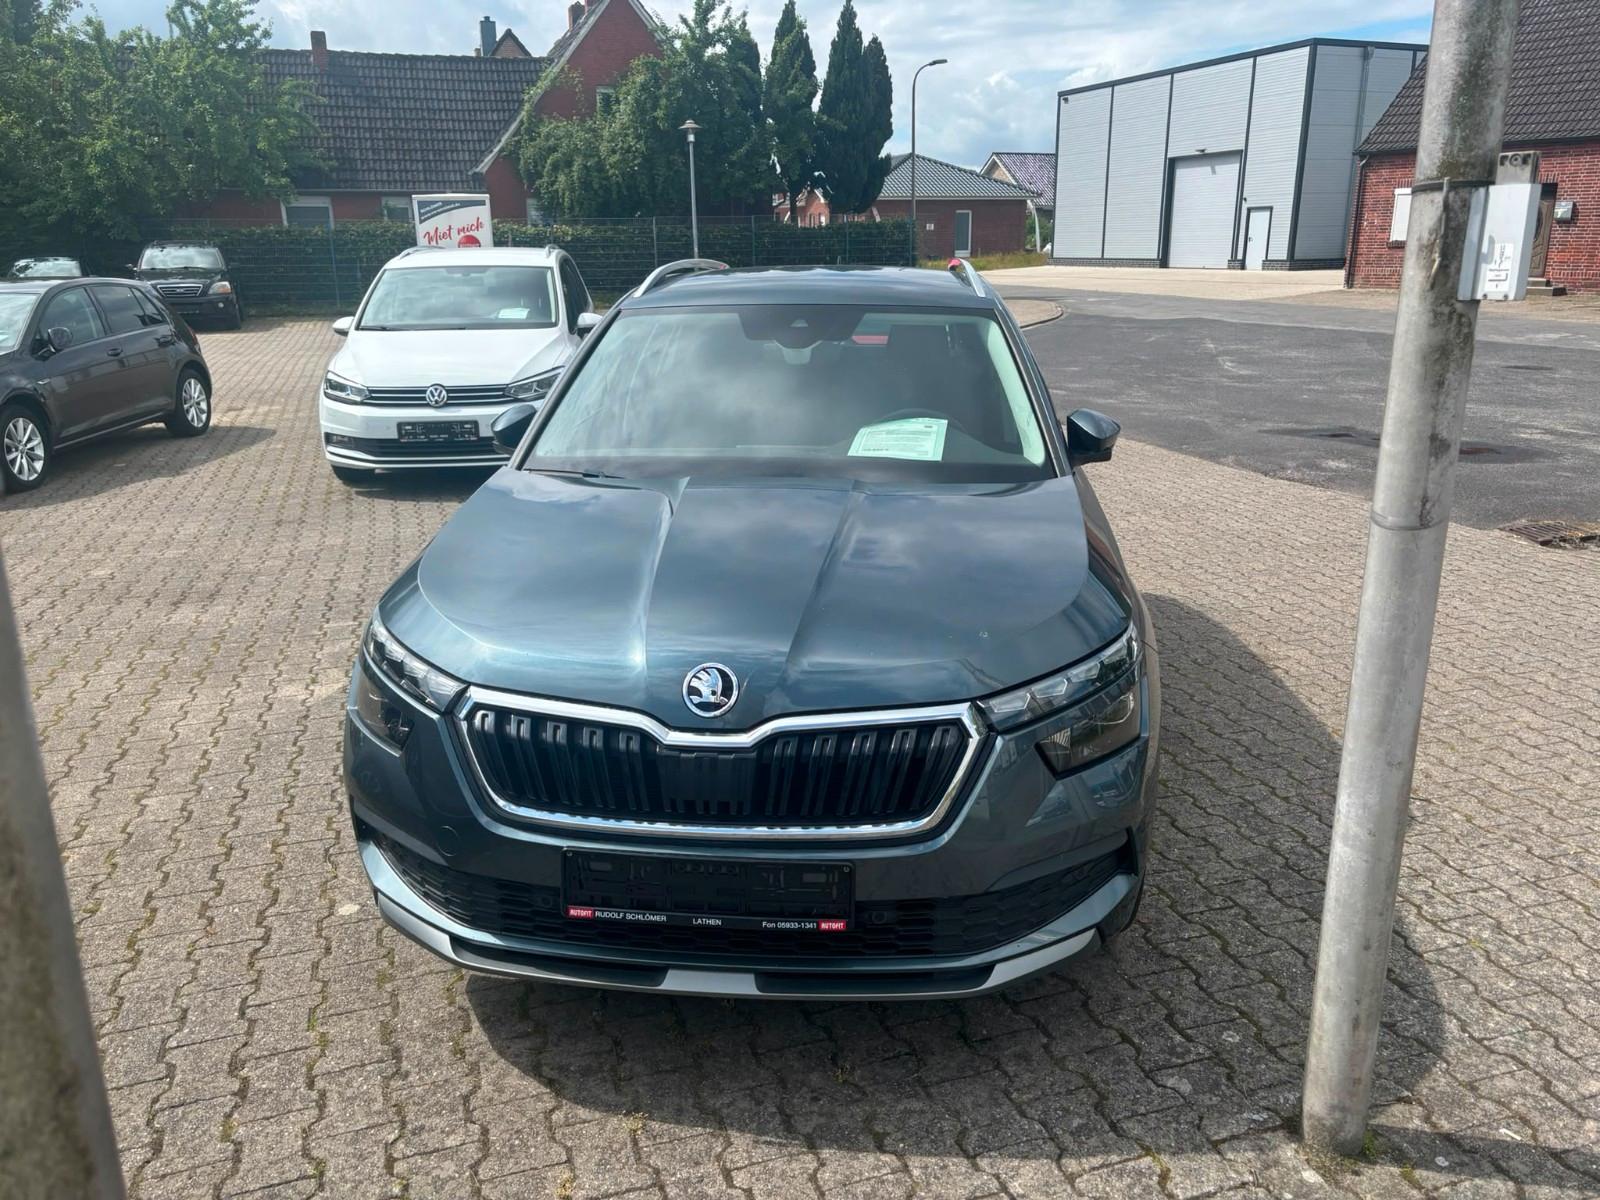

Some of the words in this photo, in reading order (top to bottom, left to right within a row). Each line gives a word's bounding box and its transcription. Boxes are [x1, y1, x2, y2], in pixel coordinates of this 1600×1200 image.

[424, 225, 452, 245] Miet
[457, 216, 484, 235] mich
[426, 385, 447, 406] VW
[595, 911, 625, 919] RUDOLF
[625, 913, 667, 922] SCHLÖMER
[692, 917, 722, 926] LATHEN
[762, 921, 776, 929] Fon
[777, 922, 817, 930] 05933-1341
